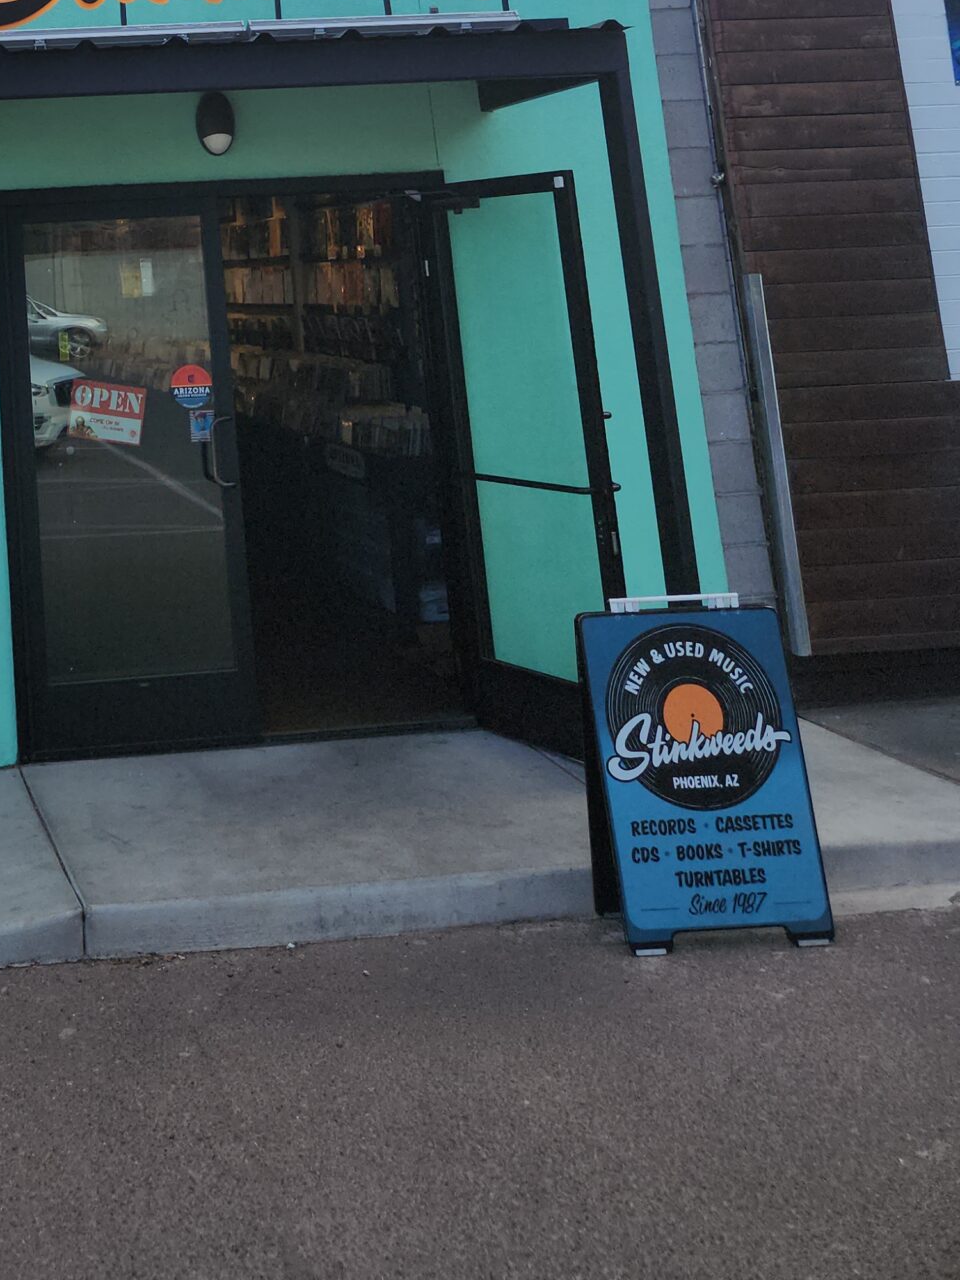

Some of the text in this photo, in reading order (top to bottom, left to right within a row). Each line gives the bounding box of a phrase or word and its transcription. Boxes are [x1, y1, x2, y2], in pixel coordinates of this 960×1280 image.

[75, 385, 143, 414] OPEN
[173, 387, 210, 396] ARIZONA
[624, 641, 754, 696] NEW & USED MUSIC
[607, 712, 791, 781] Stinkweeds
[673, 774, 740, 789] PHOENIX, AZ
[630, 814, 794, 837] RECORDS CASSETTES
[631, 839, 802, 864] CDS BOOKS T-SHIRTS
[675, 868, 767, 888] TURNTABLES
[689, 892, 767, 915] Since 1987
